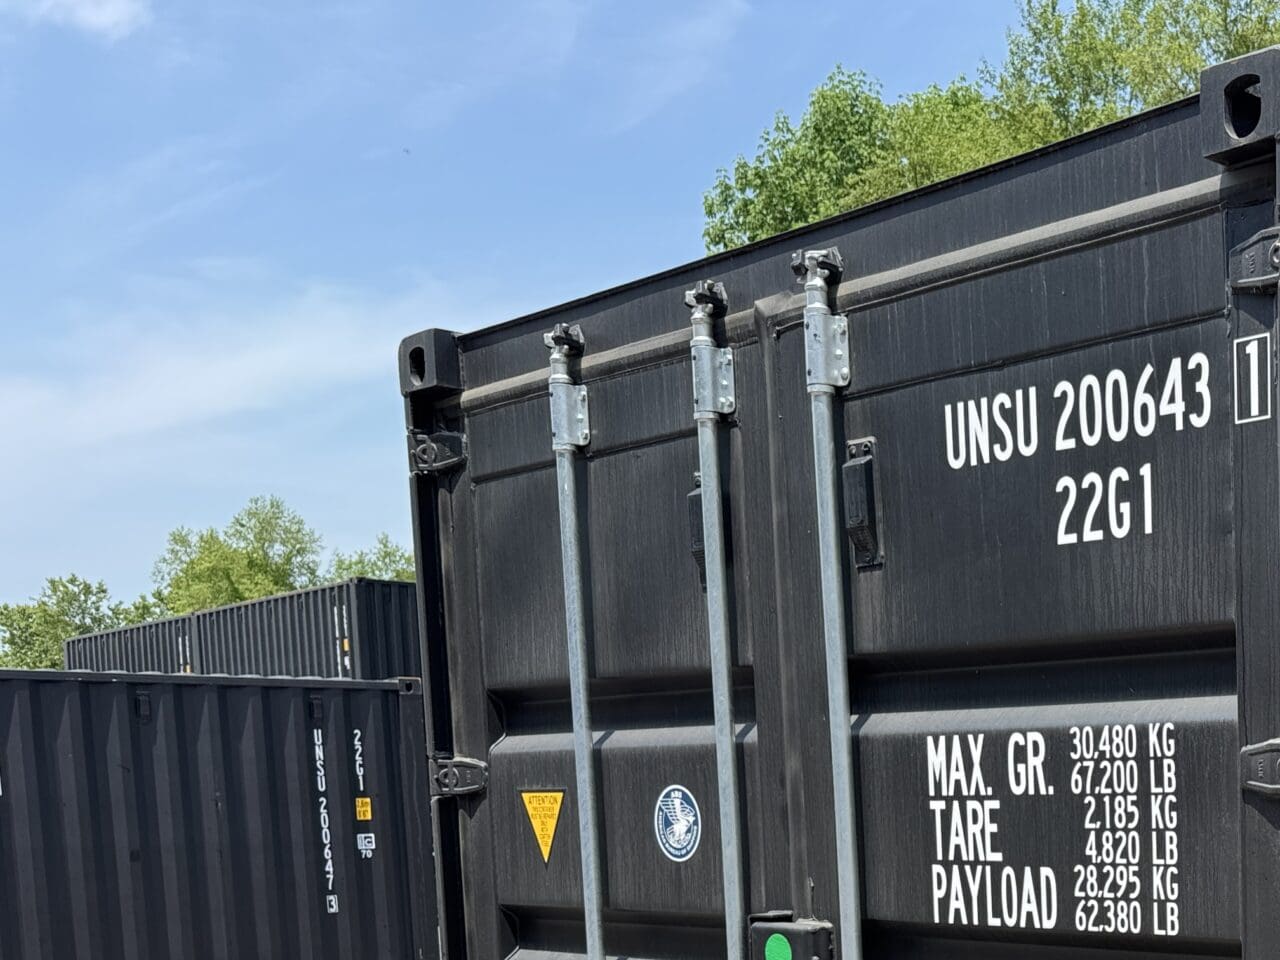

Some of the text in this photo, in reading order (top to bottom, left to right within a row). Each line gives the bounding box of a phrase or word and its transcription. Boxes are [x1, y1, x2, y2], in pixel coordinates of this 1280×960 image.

[944, 386, 1038, 470] UNSU
[1053, 351, 1212, 451] 200643
[1055, 463, 1153, 545] 22G1
[313, 728, 326, 792] UNSU
[353, 729, 364, 791] 22G1
[926, 731, 1054, 797] MAX. GR.
[1069, 722, 1175, 760] 30,480 KG
[1070, 759, 1176, 795] 67,200 LB
[929, 800, 1003, 861] TARE
[1084, 794, 1178, 829] 2,185 KG
[318, 796, 334, 890] 200647
[360, 850, 373, 859] 70
[1085, 830, 1178, 865] 4,820 LB
[931, 863, 1058, 929] PAYLOAD
[1073, 864, 1179, 900] 28,295 KG
[1075, 899, 1179, 936] 62,380 LB
